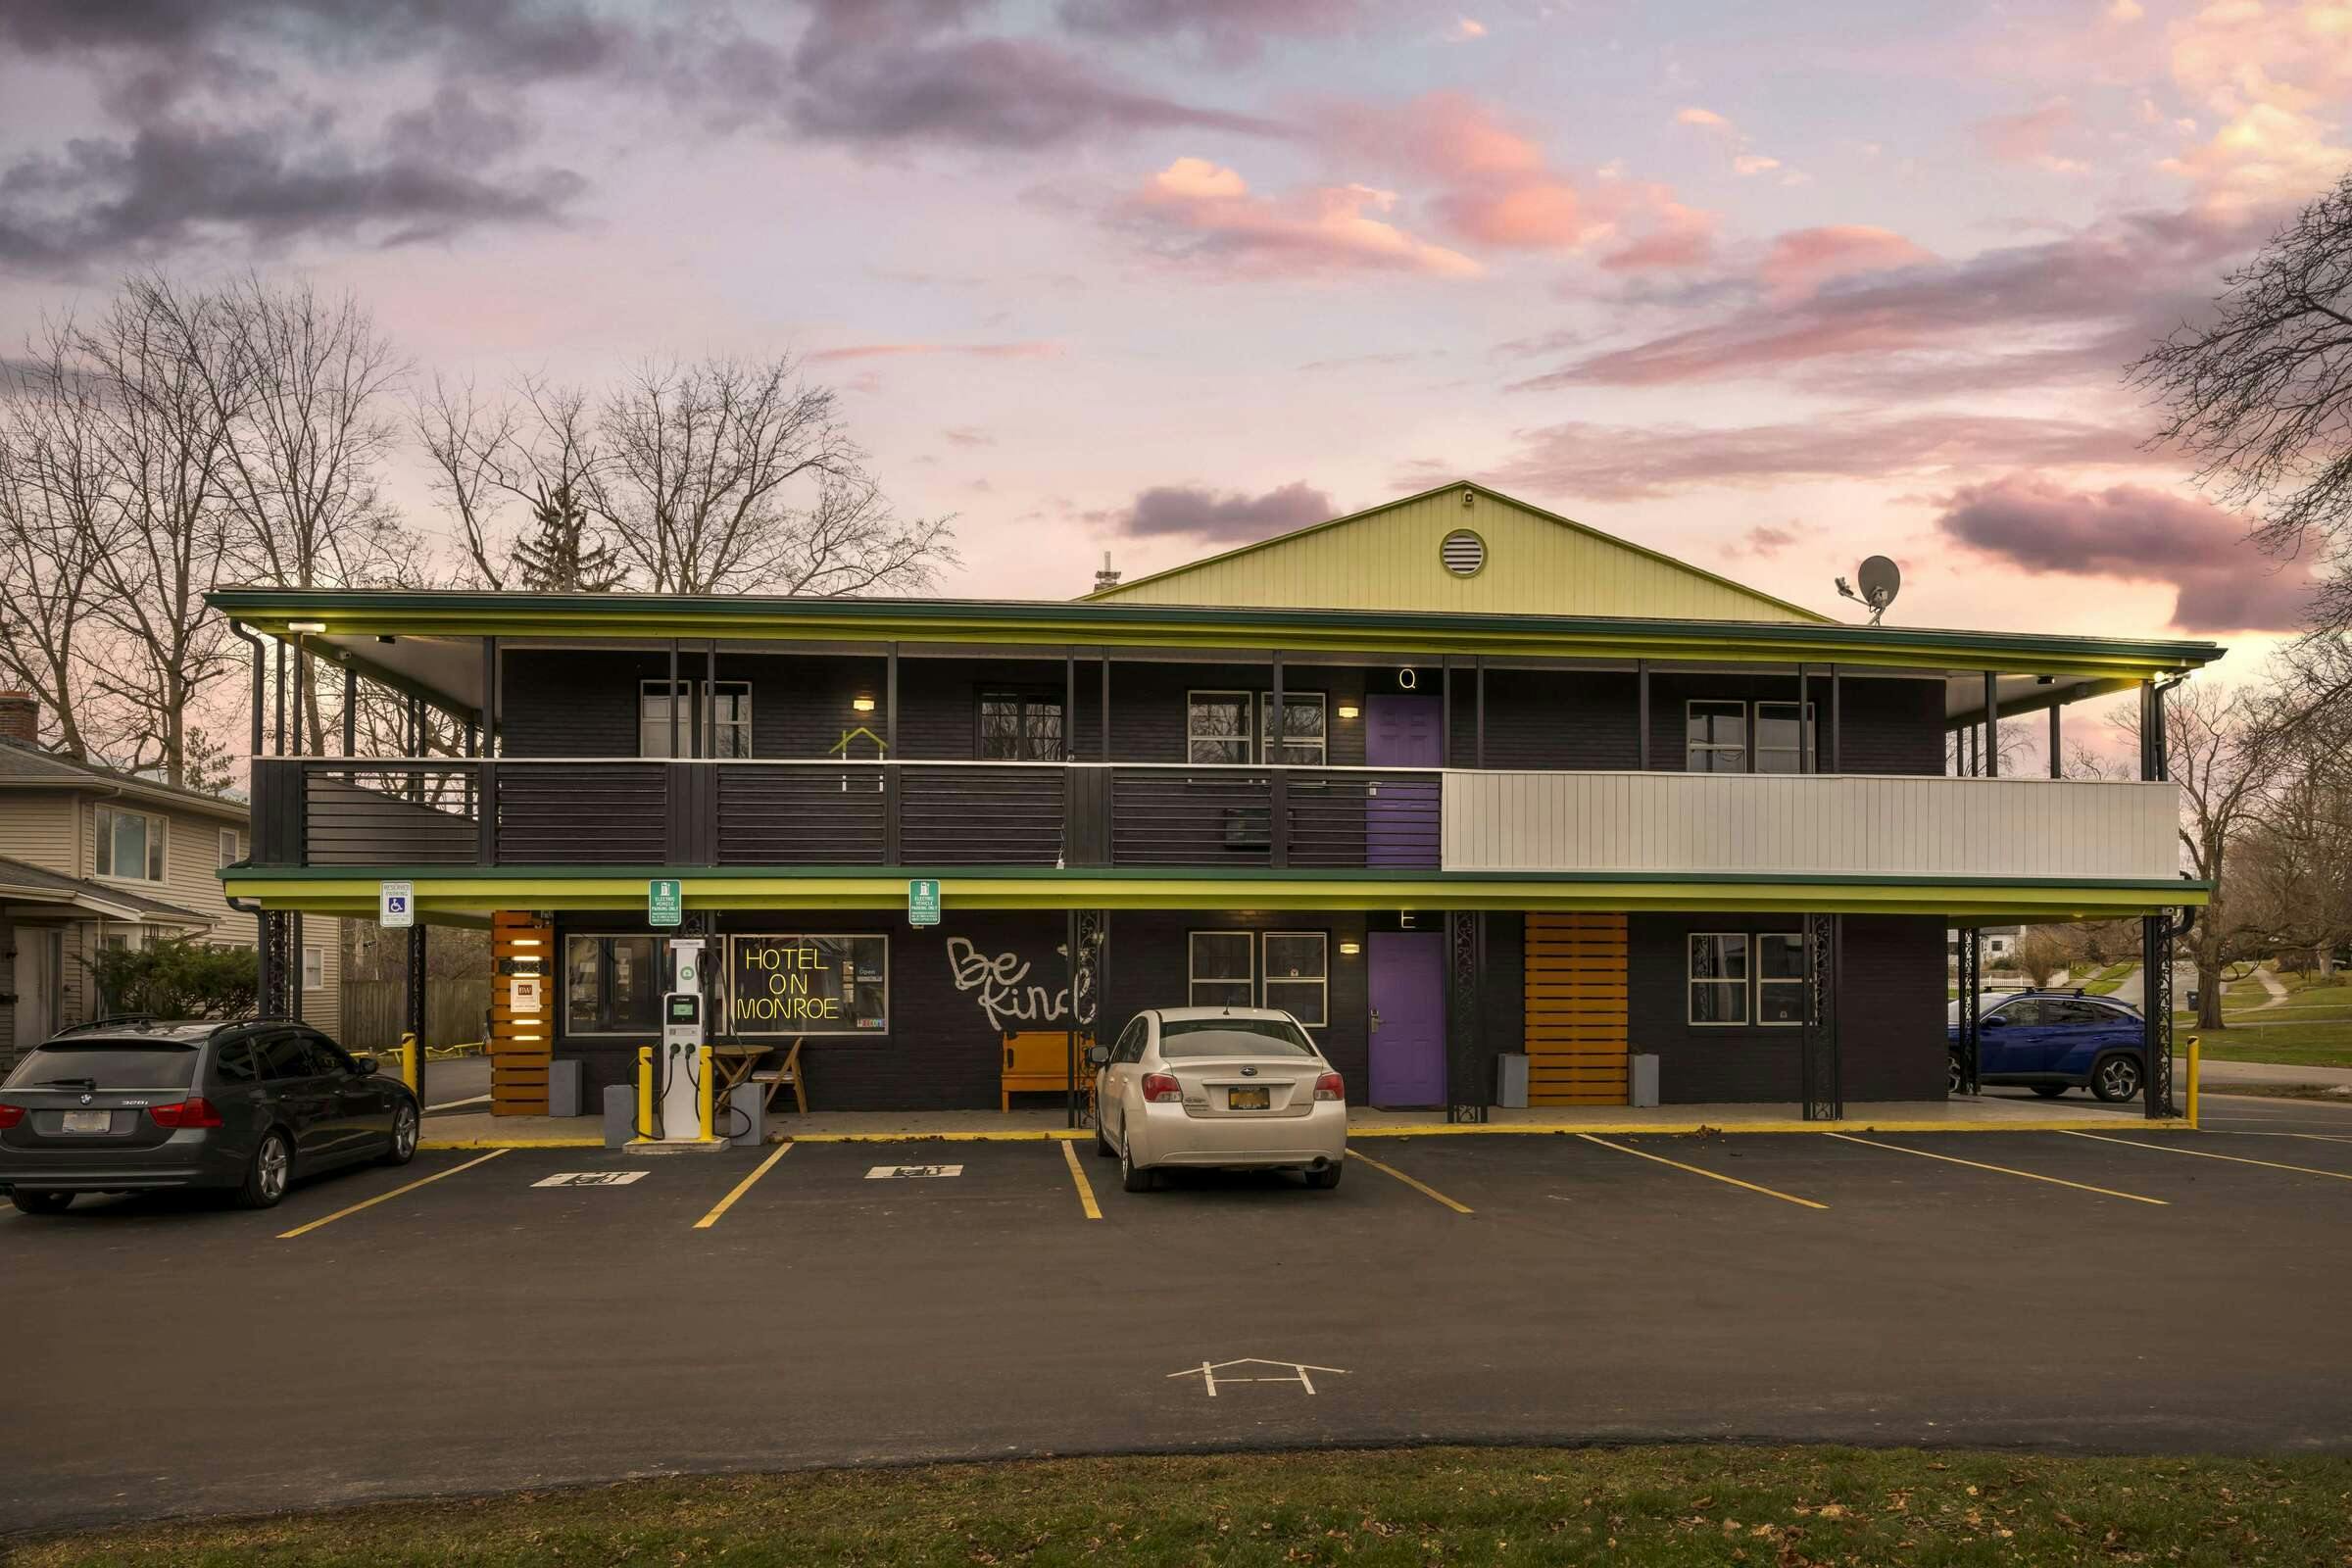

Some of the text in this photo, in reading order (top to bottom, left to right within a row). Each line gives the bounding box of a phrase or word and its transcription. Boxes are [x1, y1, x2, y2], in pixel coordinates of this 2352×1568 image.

[1399, 668, 1416, 689] Q
[746, 948, 830, 970] HOTEL
[947, 937, 1031, 991] Be
[769, 973, 808, 995] ON
[737, 998, 840, 1019] MONROE
